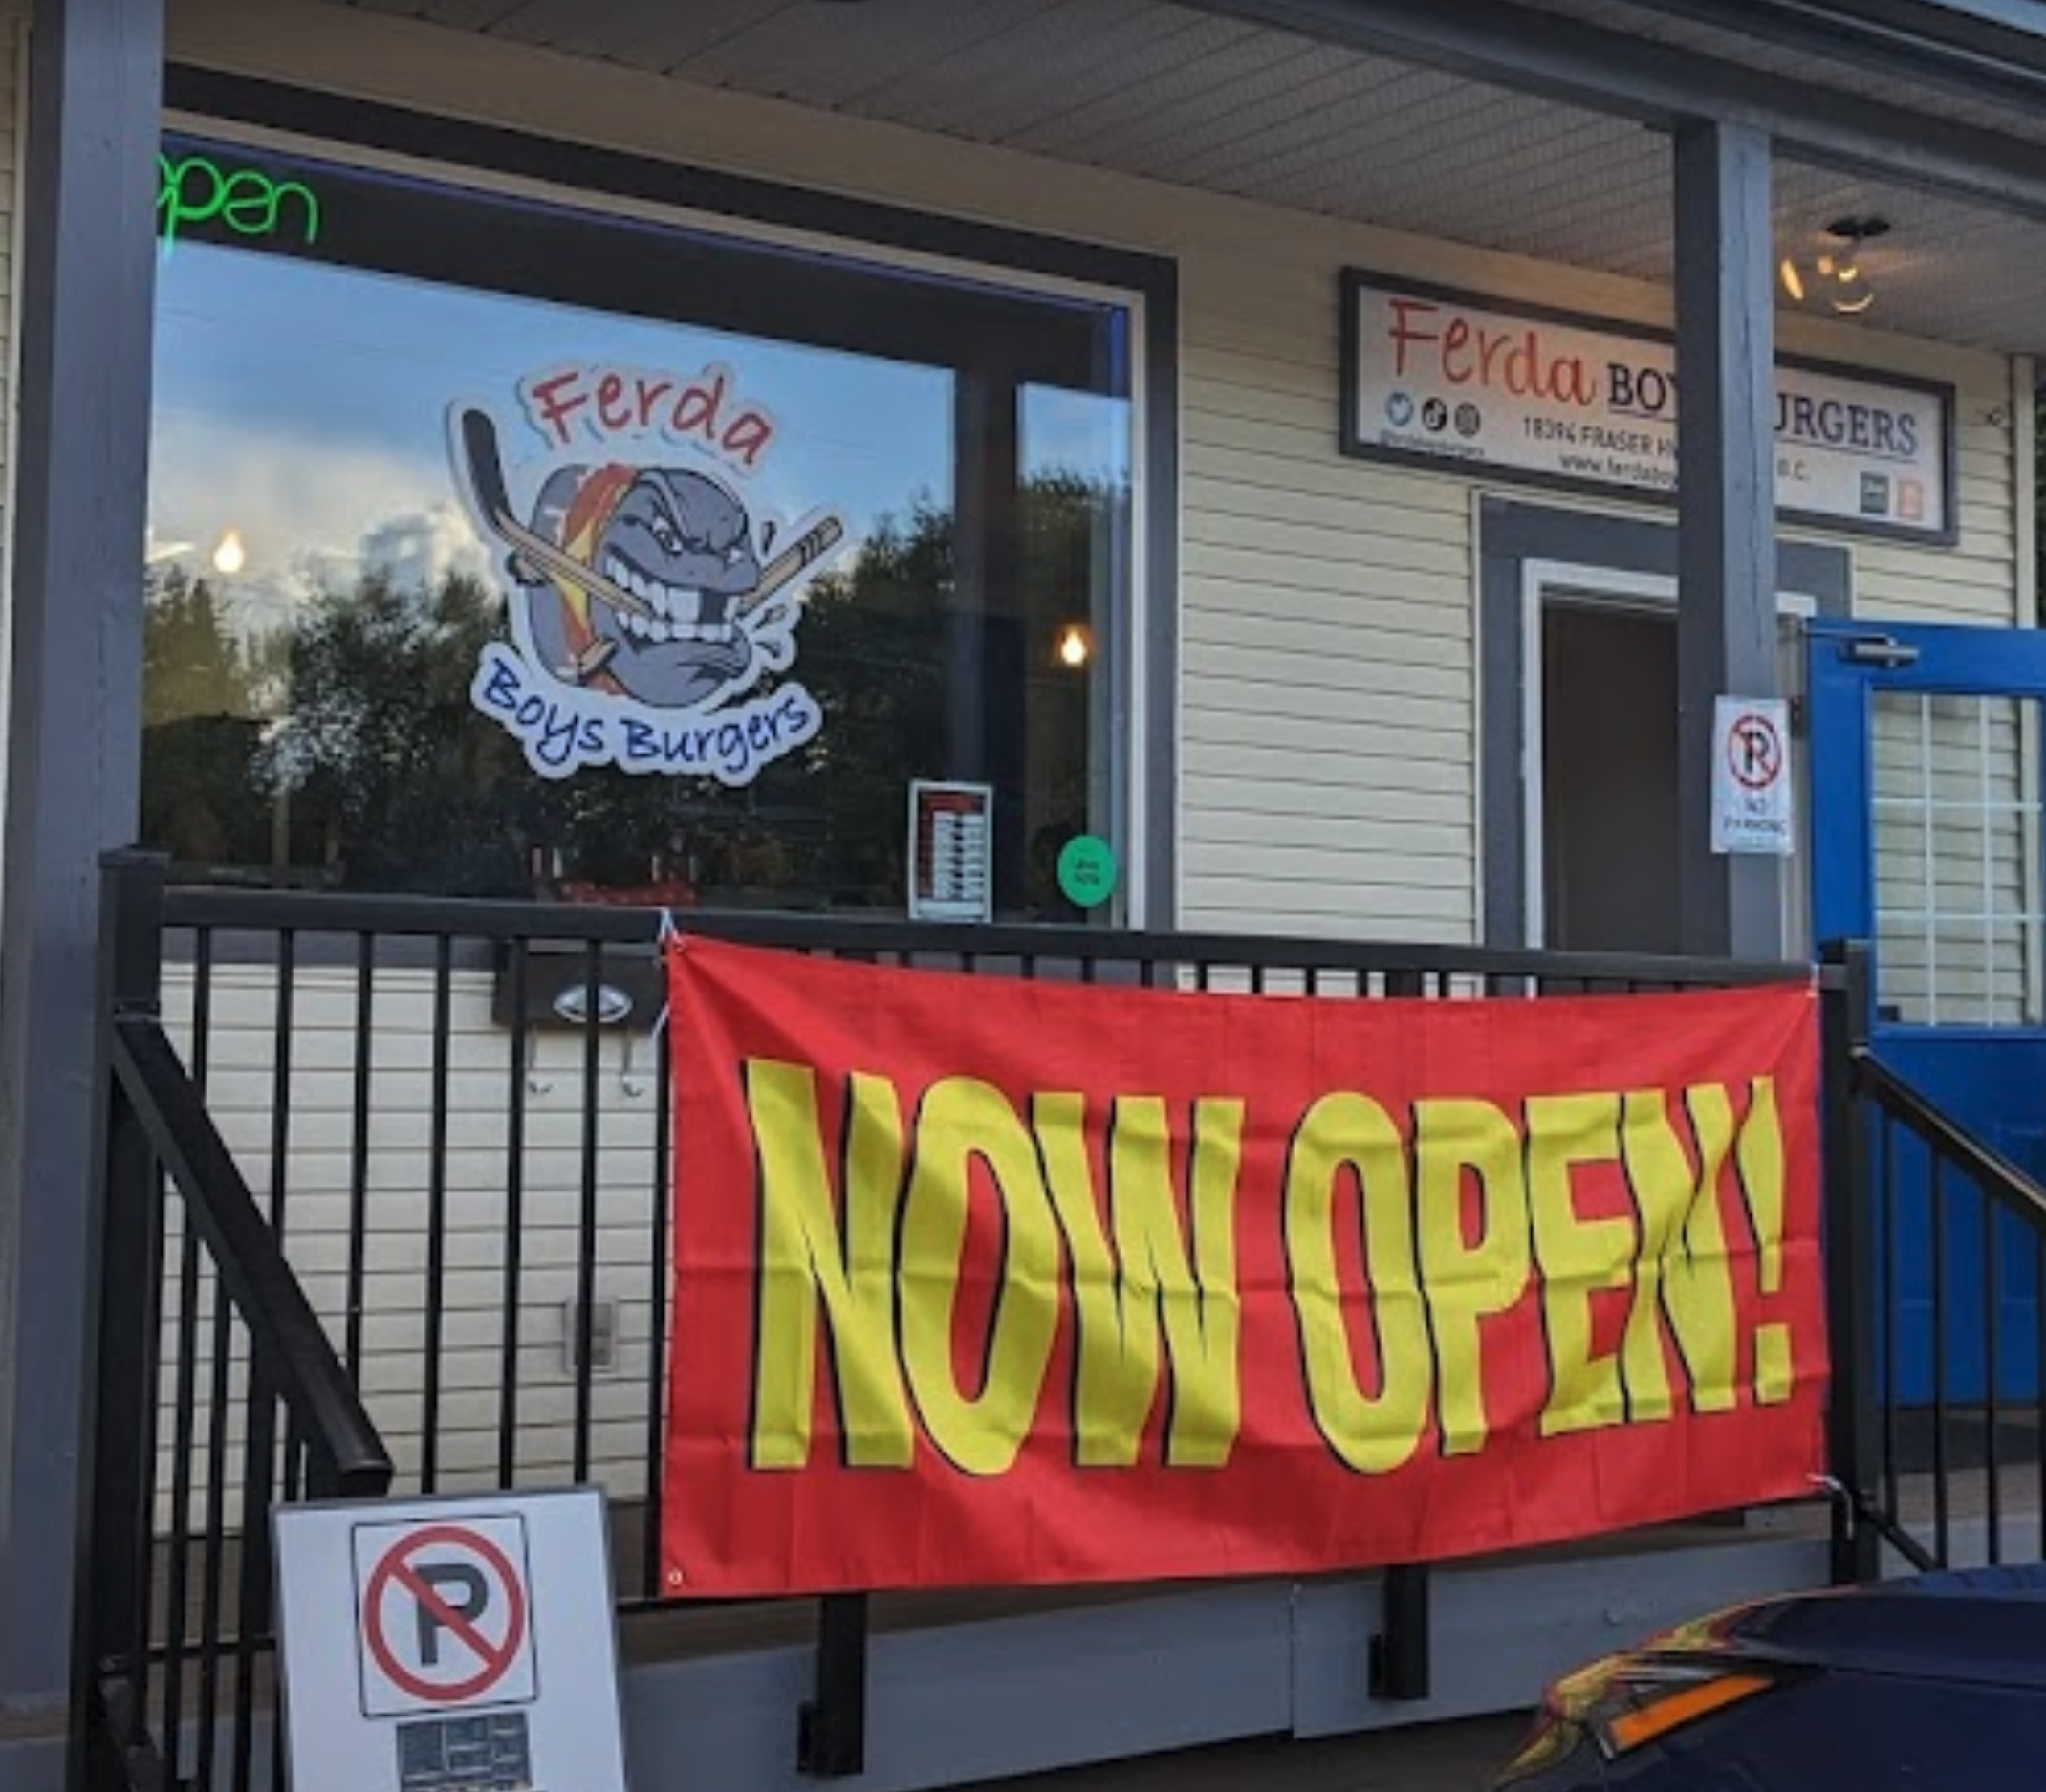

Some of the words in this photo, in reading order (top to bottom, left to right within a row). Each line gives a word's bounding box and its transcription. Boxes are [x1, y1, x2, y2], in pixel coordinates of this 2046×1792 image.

[1388, 297, 1597, 406] Ferda
[1606, 362, 1679, 412] BO
[532, 371, 773, 466] Ferda
[1580, 426, 1653, 456] FRASER
[483, 658, 605, 765] Boys
[620, 696, 811, 773] Burgers
[742, 1059, 1245, 1476] NOW
[1282, 1075, 1793, 1475] OPEN!
